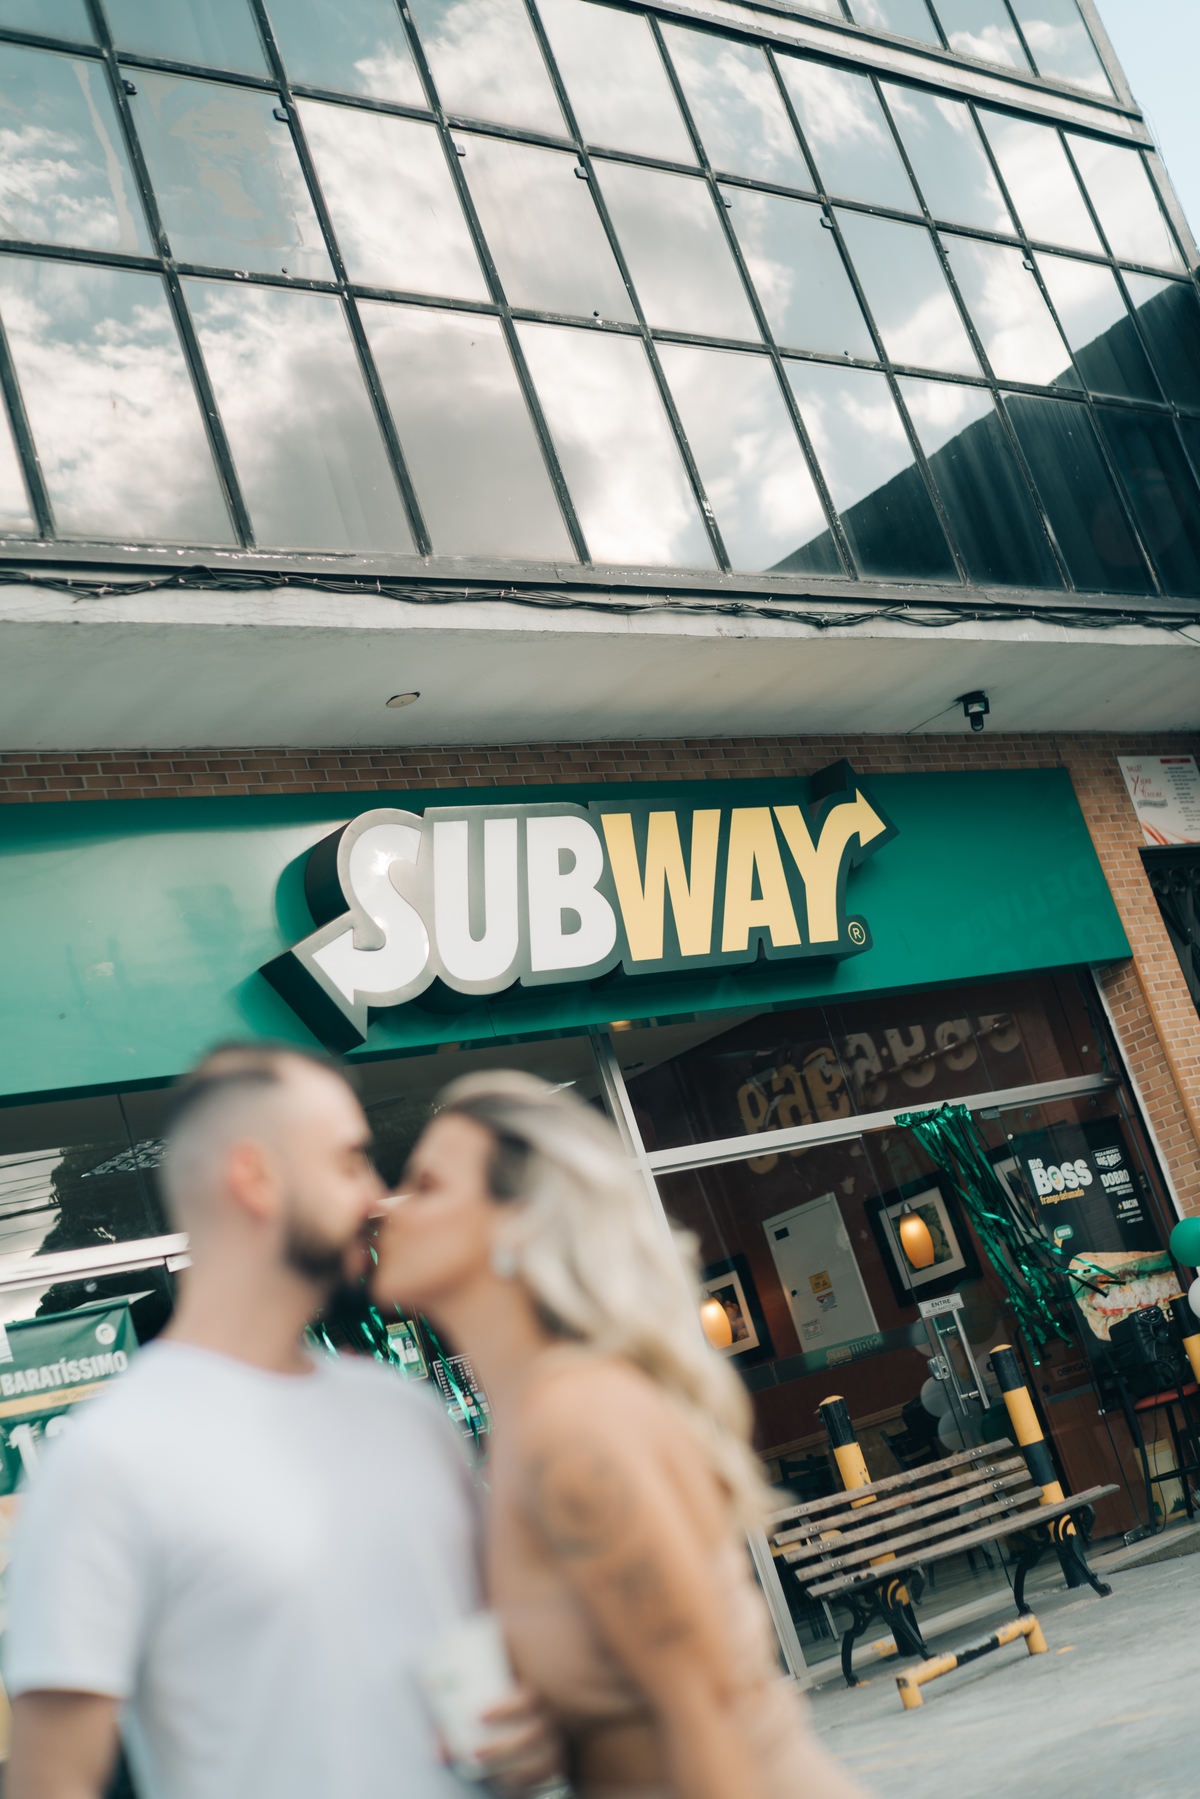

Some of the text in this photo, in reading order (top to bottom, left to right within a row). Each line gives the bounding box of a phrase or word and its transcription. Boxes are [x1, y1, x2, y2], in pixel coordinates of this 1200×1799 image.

[312, 787, 887, 1005] SUBWAY
[1027, 1158, 1044, 1170] BIG
[1031, 1159, 1093, 1196] BOSS
[1100, 1169, 1130, 1187] DOBRO
[931, 1299, 951, 1308] ENTRE
[826, 1336, 879, 1363] SUBWAY
[1, 1350, 128, 1396] BARATÍSSIMO
